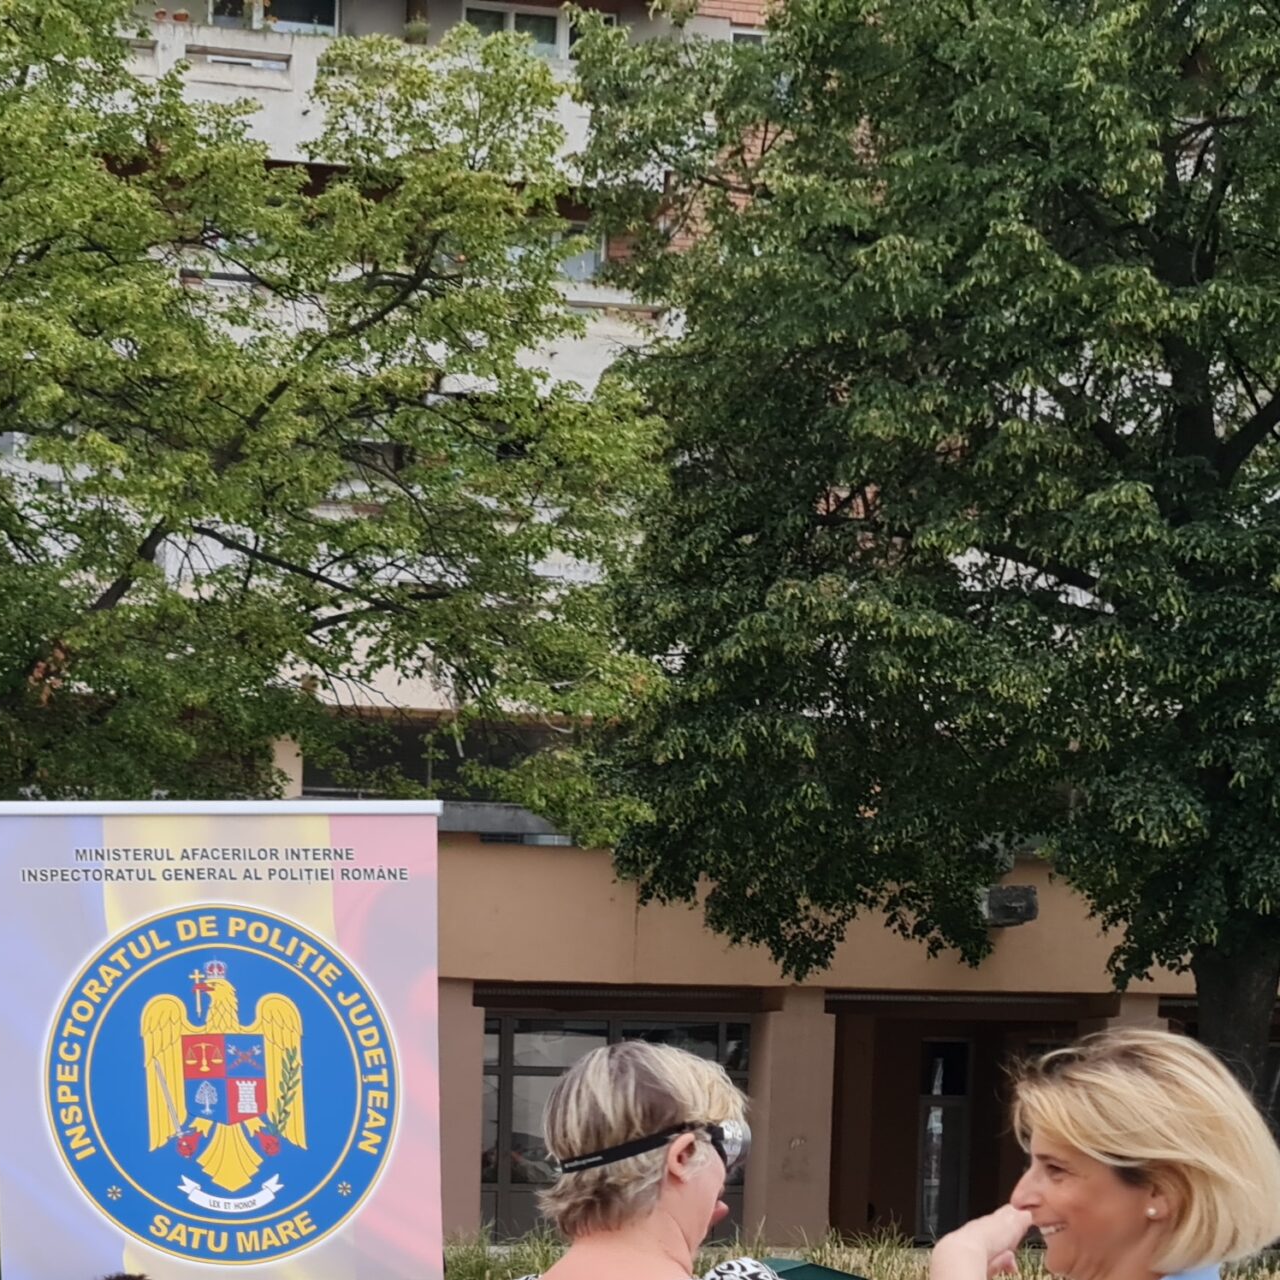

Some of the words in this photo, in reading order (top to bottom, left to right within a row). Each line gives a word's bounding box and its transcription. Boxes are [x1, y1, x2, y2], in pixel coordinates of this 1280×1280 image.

[75, 848, 175, 862] MINISTERUL
[180, 848, 280, 861] AFACERILOR
[285, 848, 355, 861] INTERNE
[21, 868, 157, 882] INSPECTORATUL
[162, 868, 238, 881] GENERAL
[242, 868, 262, 881] AL
[340, 865, 409, 881] ROMÂNE
[56, 929, 172, 1162] INSPECTORATUL
[175, 915, 219, 942] DE
[148, 1213, 229, 1254] SATU
[235, 1210, 318, 1254] MARE
